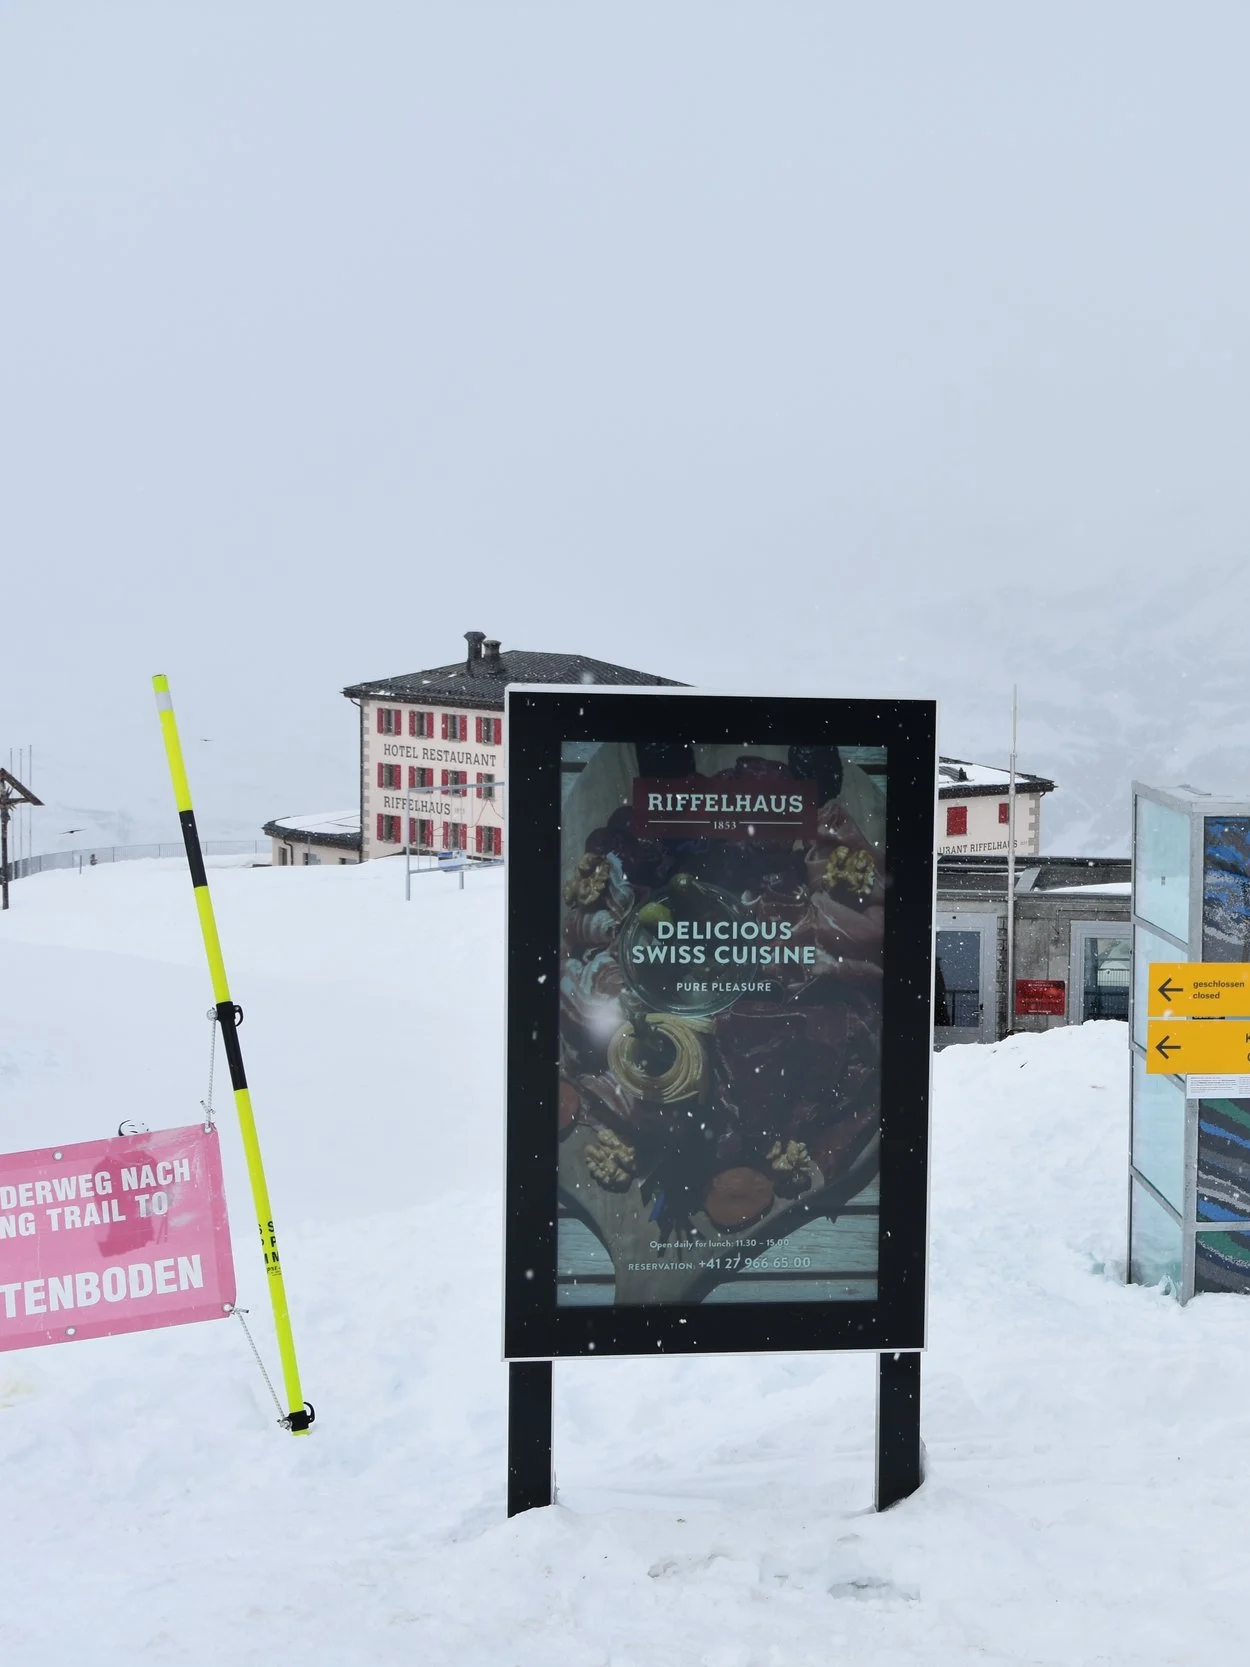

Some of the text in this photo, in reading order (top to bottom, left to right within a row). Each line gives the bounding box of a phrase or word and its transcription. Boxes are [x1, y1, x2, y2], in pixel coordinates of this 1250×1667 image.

[384, 744, 496, 767] HOTEL RESTAURANT
[384, 796, 450, 815] RIFFELHAUS
[648, 793, 803, 812] RIFFELHAUS
[713, 822, 736, 830] 1853
[658, 922, 792, 939] DELICIOUS
[632, 946, 816, 964] SWISS CUISINE
[677, 983, 772, 992] PURE PLEASURE
[1193, 980, 1244, 989] geschlossen
[0, 1158, 190, 1210] DERWEG NACH
[0, 1192, 168, 1240] NG TRAIL TO
[650, 1240, 672, 1250] Open
[674, 1240, 693, 1250] daily
[695, 1240, 707, 1248] for
[699, 1258, 720, 1269] +41
[725, 1258, 740, 1269] 27
[744, 1258, 768, 1268] 966
[0, 1254, 204, 1318] TENBODEN
